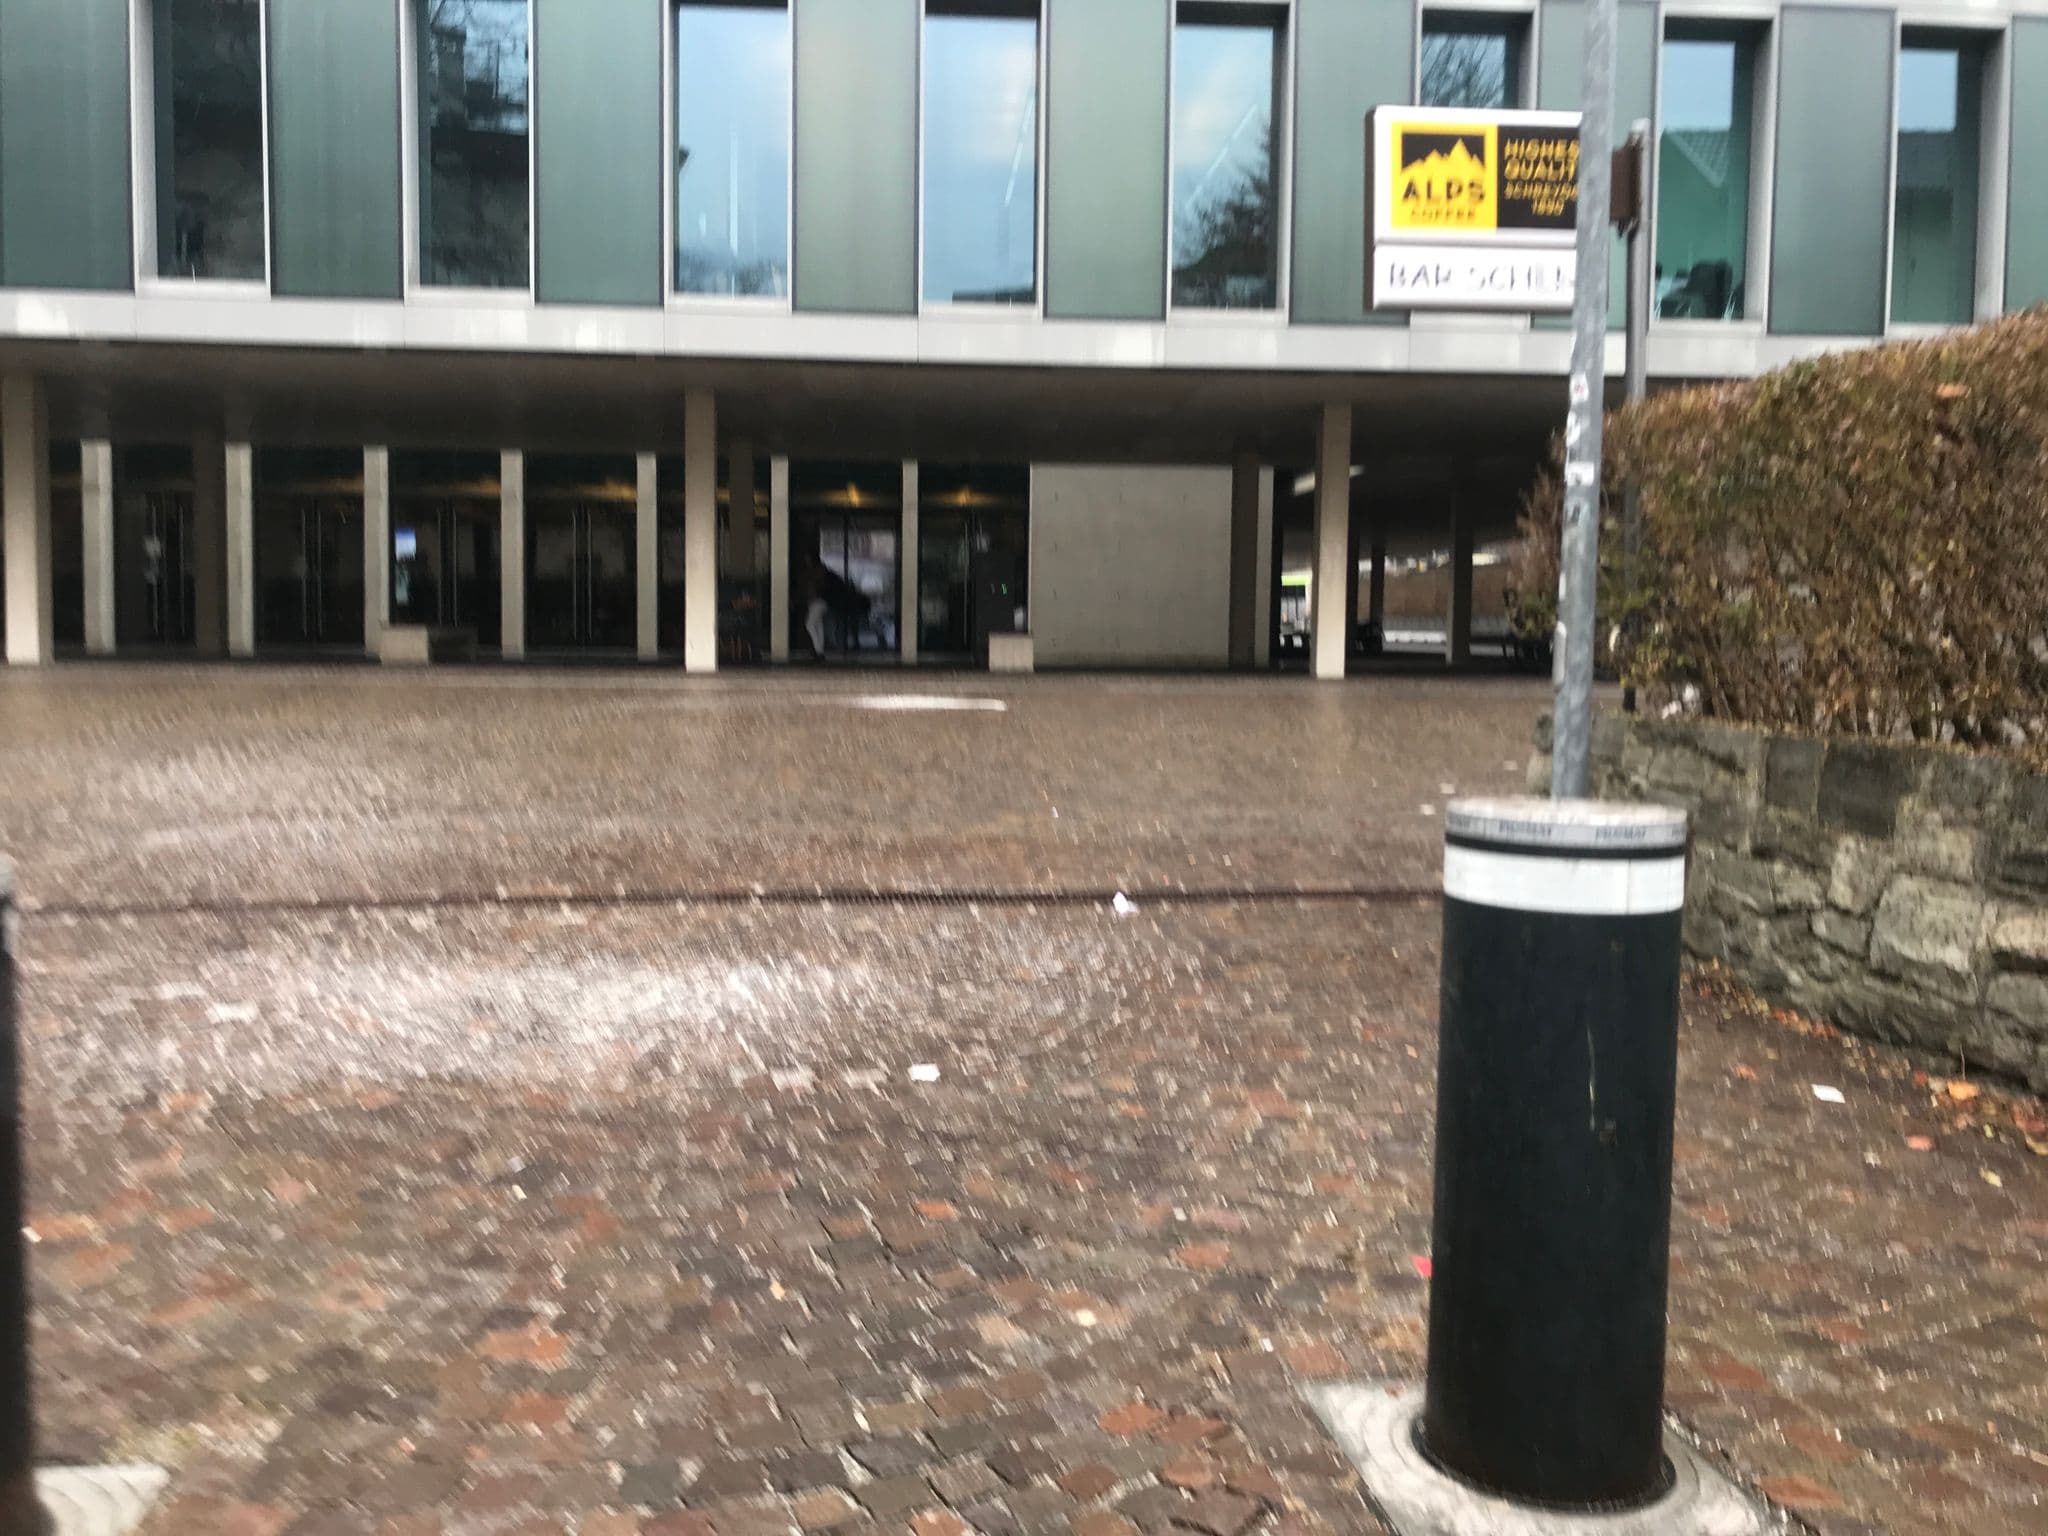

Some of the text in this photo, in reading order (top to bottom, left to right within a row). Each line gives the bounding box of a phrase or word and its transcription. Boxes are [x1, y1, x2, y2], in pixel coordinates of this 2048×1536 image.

[1503, 137, 1579, 161] HIGHES
[1503, 157, 1579, 182] QUALIT
[1401, 177, 1486, 203] ALPS
[1388, 261, 1451, 289] BAR
